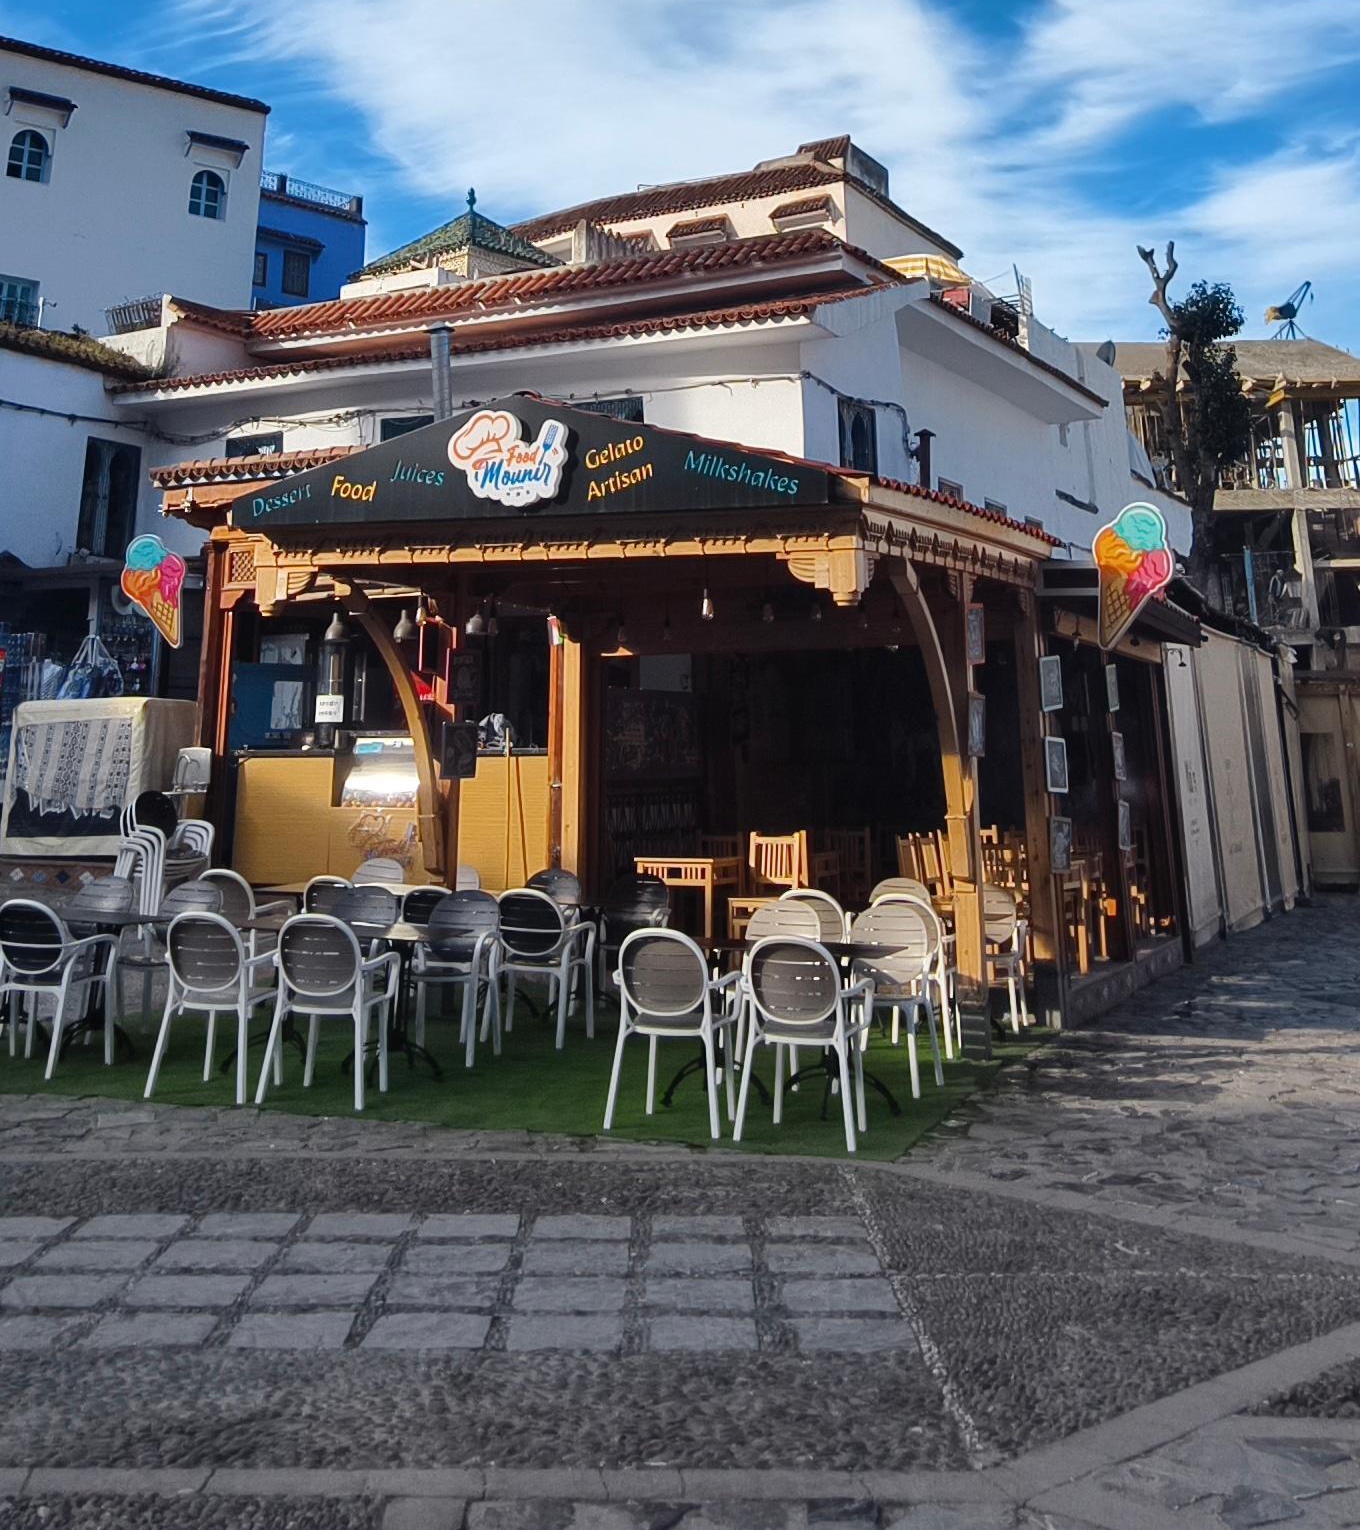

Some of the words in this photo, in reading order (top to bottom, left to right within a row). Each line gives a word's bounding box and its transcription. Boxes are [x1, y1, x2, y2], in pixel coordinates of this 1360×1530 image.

[506, 444, 540, 467] Food
[584, 435, 644, 469] Gelato
[331, 474, 377, 502] Food
[390, 459, 445, 486] Juices
[475, 458, 551, 490] Mounir
[587, 463, 653, 502] Artisan
[684, 449, 799, 495] Milkshakes
[252, 483, 311, 517] Dessert
